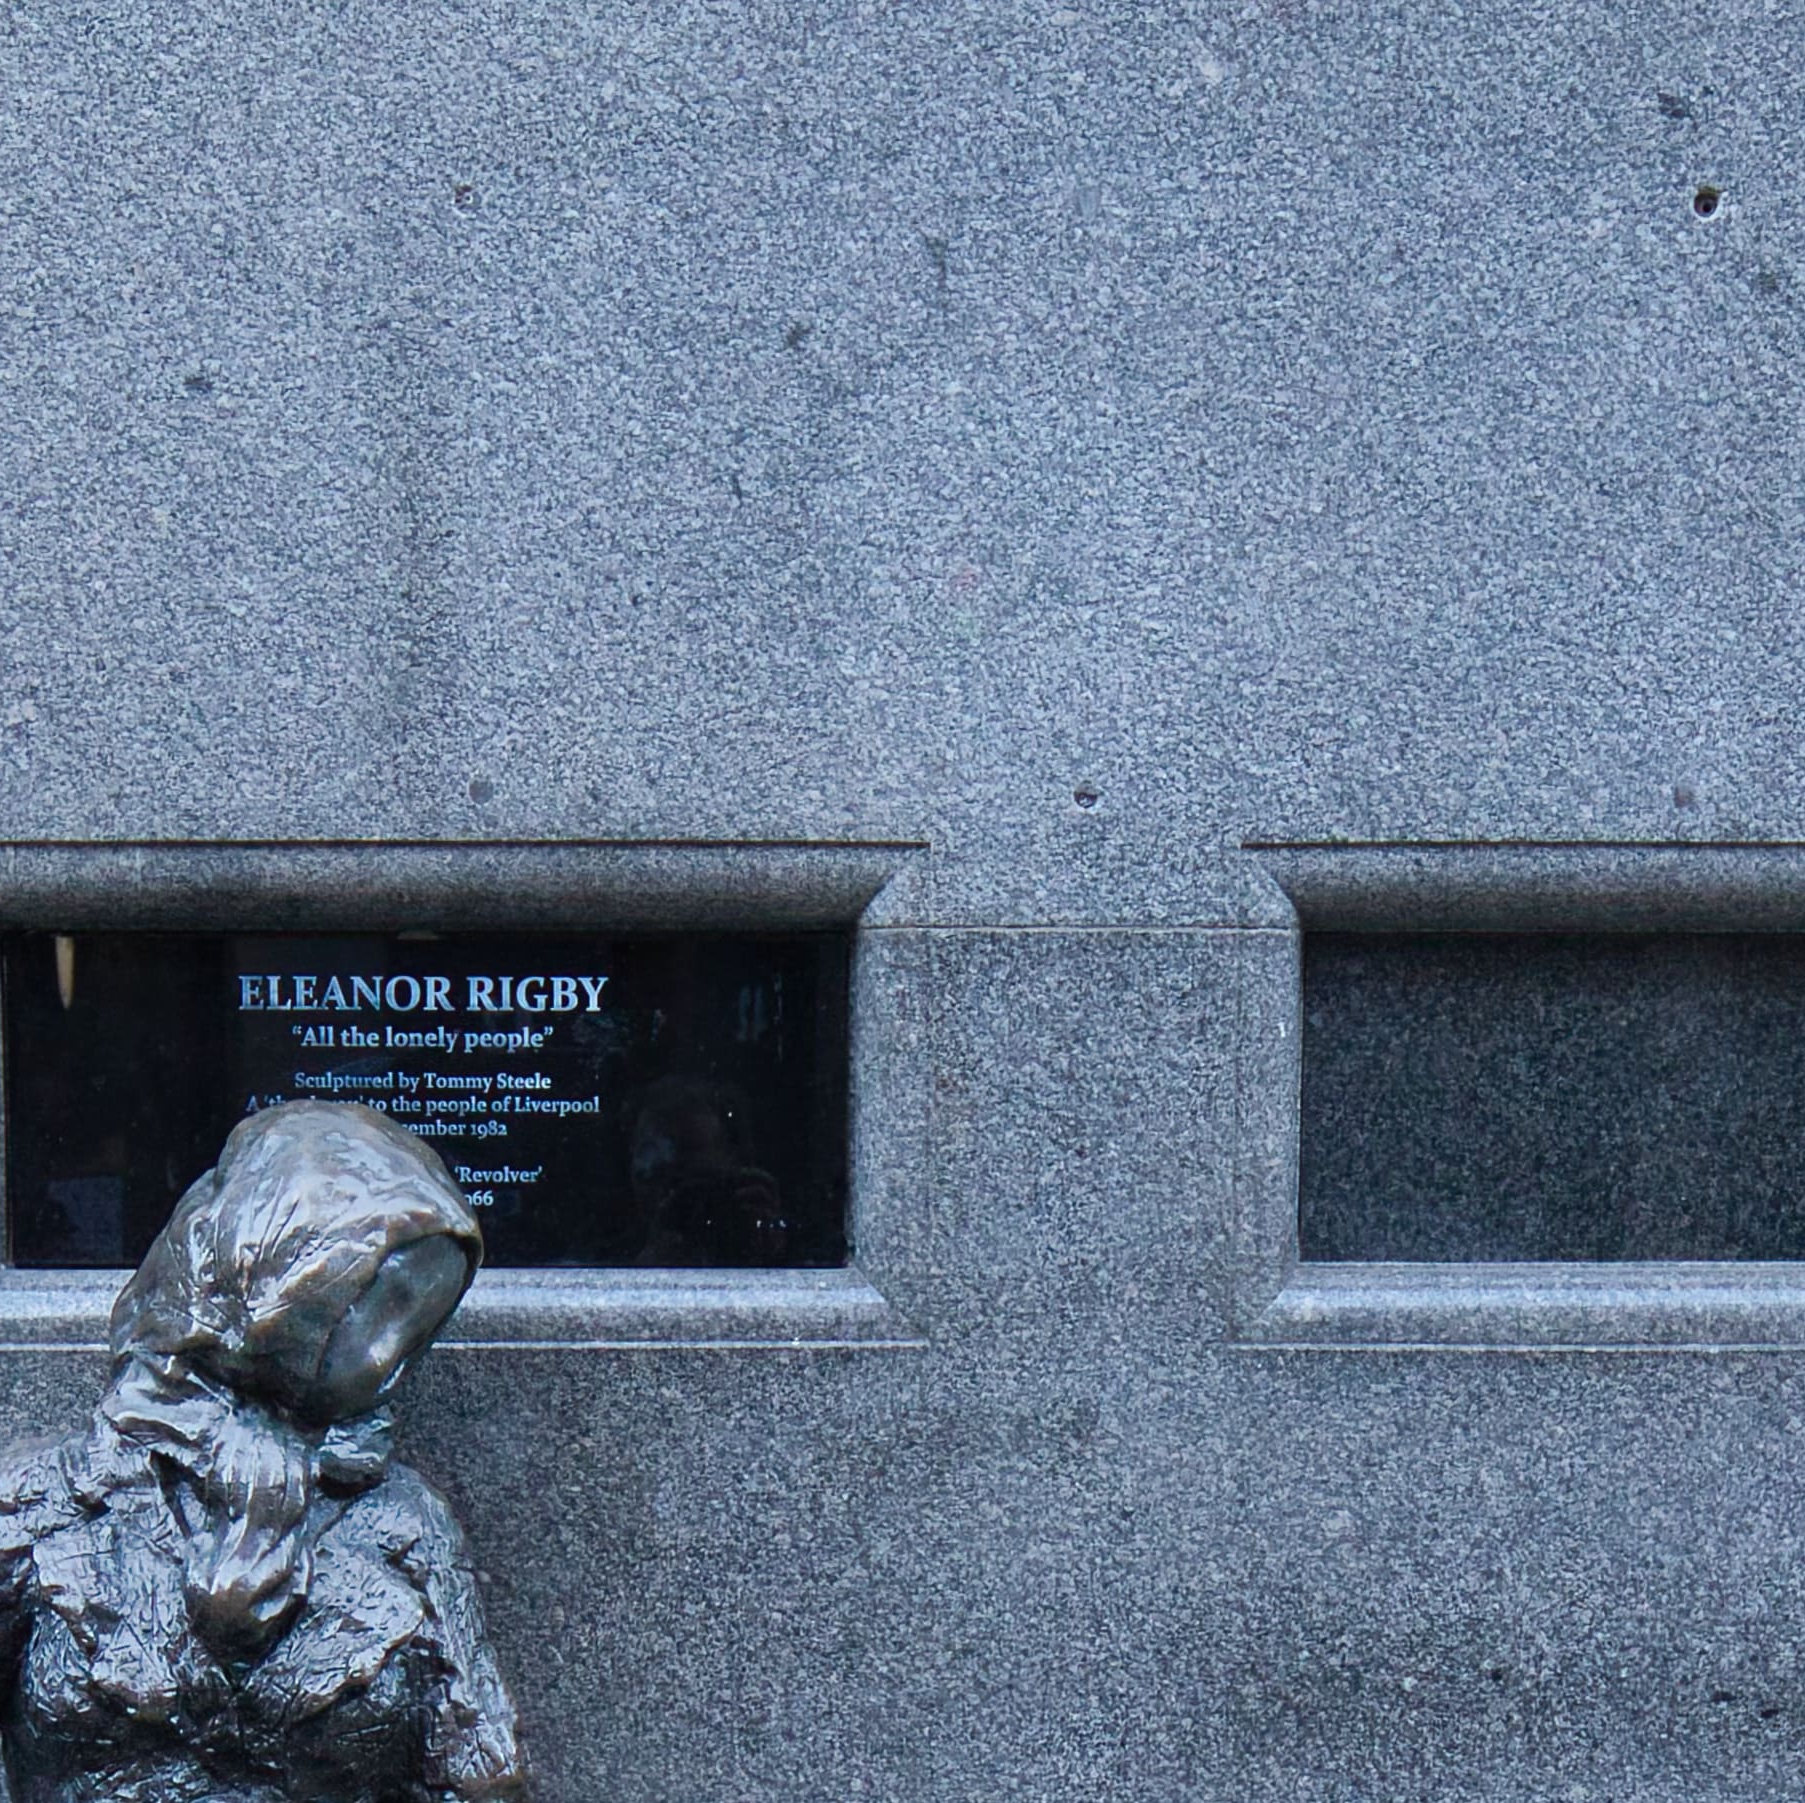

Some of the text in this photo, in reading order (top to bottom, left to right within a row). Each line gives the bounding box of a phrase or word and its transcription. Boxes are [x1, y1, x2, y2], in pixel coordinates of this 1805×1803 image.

[238, 975, 609, 1011] ELEANOR RIGBY
[292, 1025, 553, 1053] “All the lonely people”
[295, 1072, 552, 1093] Sculptured by Tommy Steele
[246, 1095, 261, 1112] A
[368, 1097, 387, 1112] to
[392, 1096, 421, 1112] the
[425, 1095, 487, 1117] people
[491, 1095, 511, 1112] of
[514, 1096, 601, 1116] Liverpool
[401, 1119, 508, 1139] ember 1982
[454, 1166, 543, 1183] ‘Revolver’
